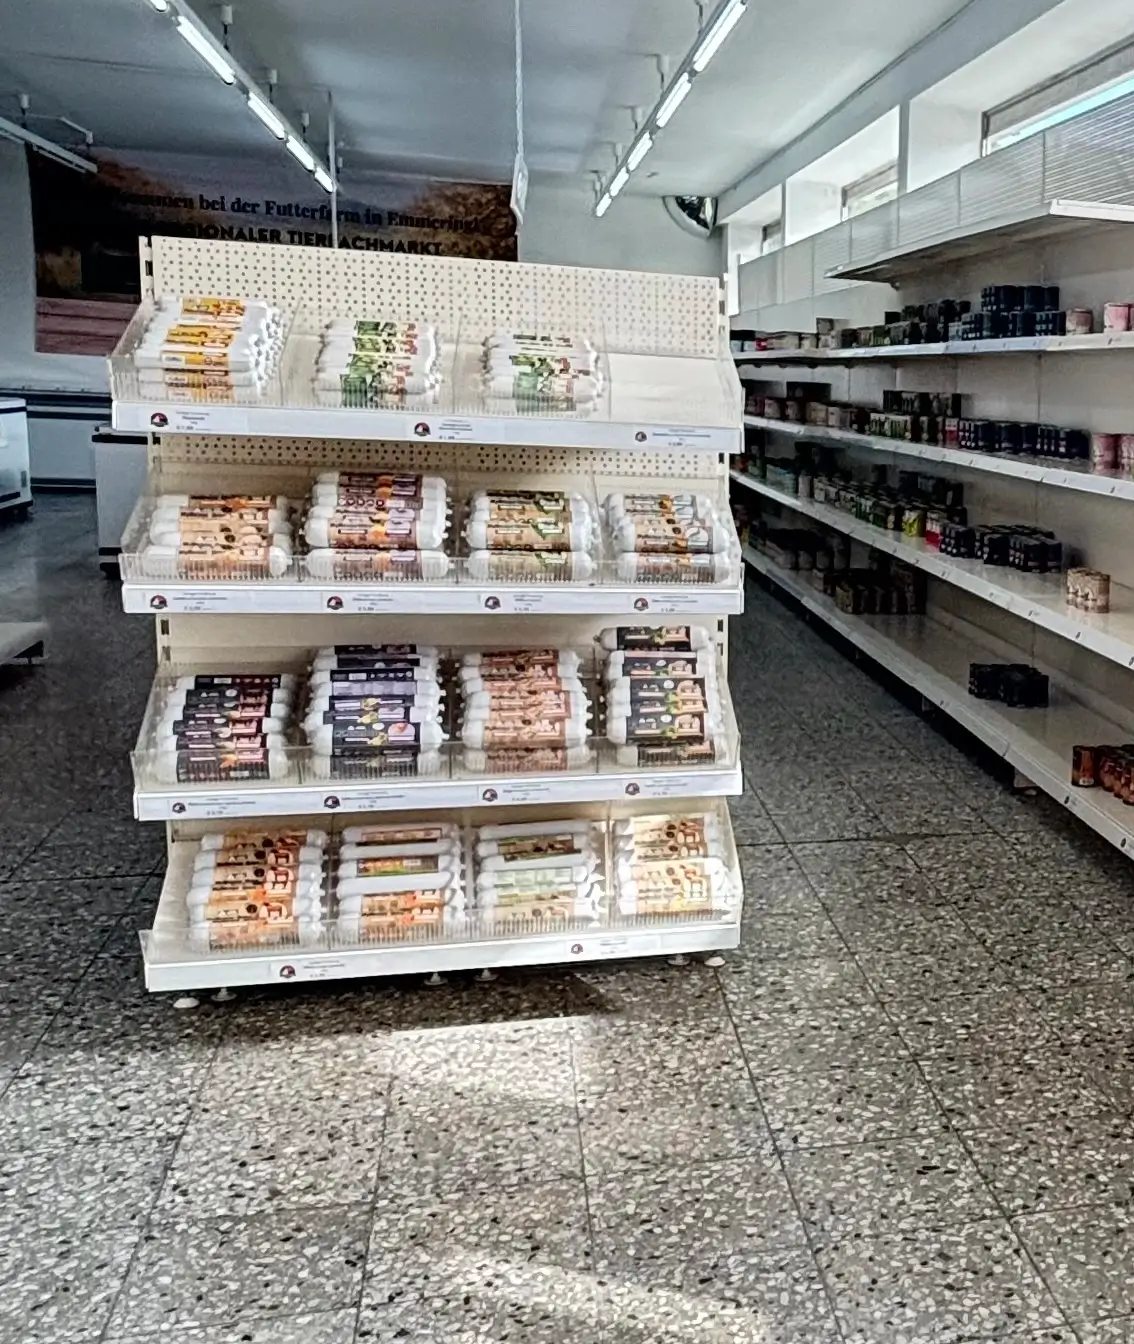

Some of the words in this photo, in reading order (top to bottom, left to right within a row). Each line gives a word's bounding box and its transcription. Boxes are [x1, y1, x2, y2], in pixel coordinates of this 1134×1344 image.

[199, 194, 226, 212] bei
[230, 197, 261, 215] der
[365, 207, 382, 225] in
